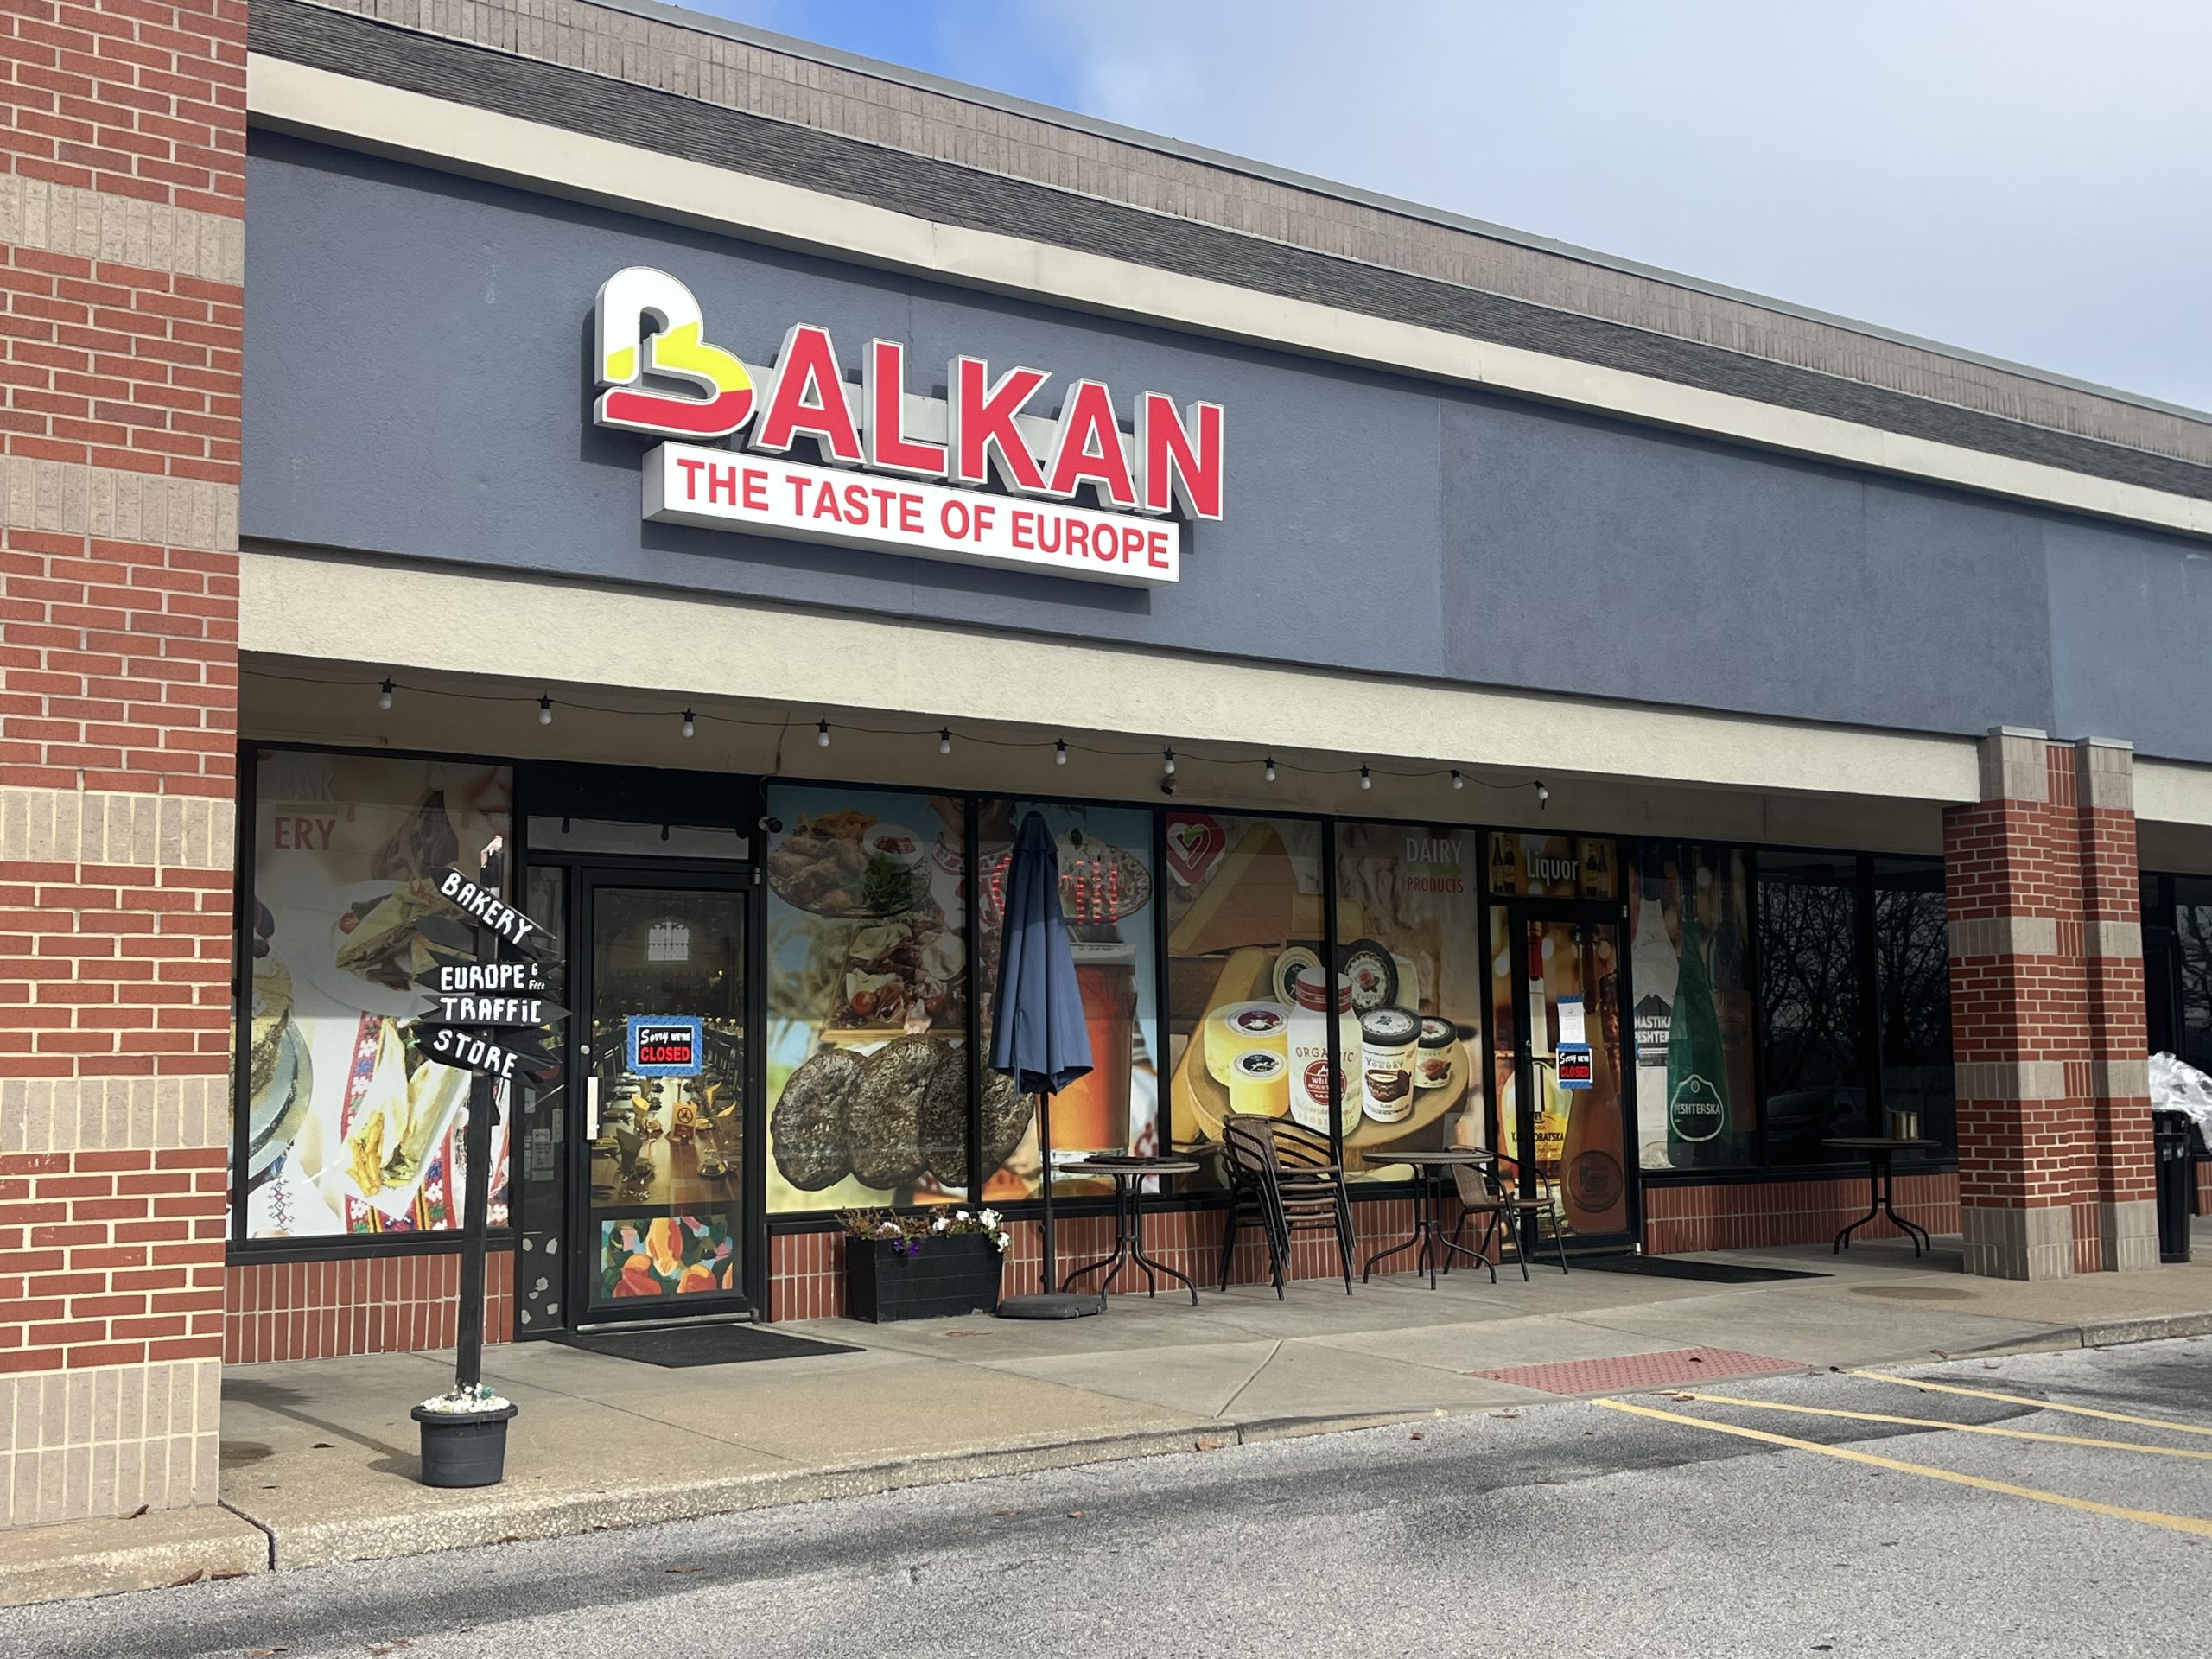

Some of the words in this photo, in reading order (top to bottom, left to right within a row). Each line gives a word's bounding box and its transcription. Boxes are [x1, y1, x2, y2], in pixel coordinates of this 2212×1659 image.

[594, 266, 1224, 521] BALKAN
[677, 458, 769, 512] THE
[785, 474, 925, 534] TASTE
[940, 499, 995, 543] OF
[1011, 510, 1170, 569] EUROPE
[274, 817, 336, 851] ERY
[1405, 836, 1463, 865] DAIRY
[1525, 848, 1579, 887] Liquor
[1406, 875, 1465, 893] PRODUCTS
[440, 872, 534, 944] BAKERY
[440, 964, 524, 991] EUROPE
[640, 1028, 670, 1045] Sorry
[432, 1028, 518, 1079] STORE
[640, 1046, 690, 1062] CLOSED
[1295, 1046, 1354, 1062] ORGAIC
[1560, 1065, 1590, 1077] CLOSED
[1673, 1103, 1721, 1115] PESHTERSKA
[1510, 1131, 1565, 1142] KOBATSKA
